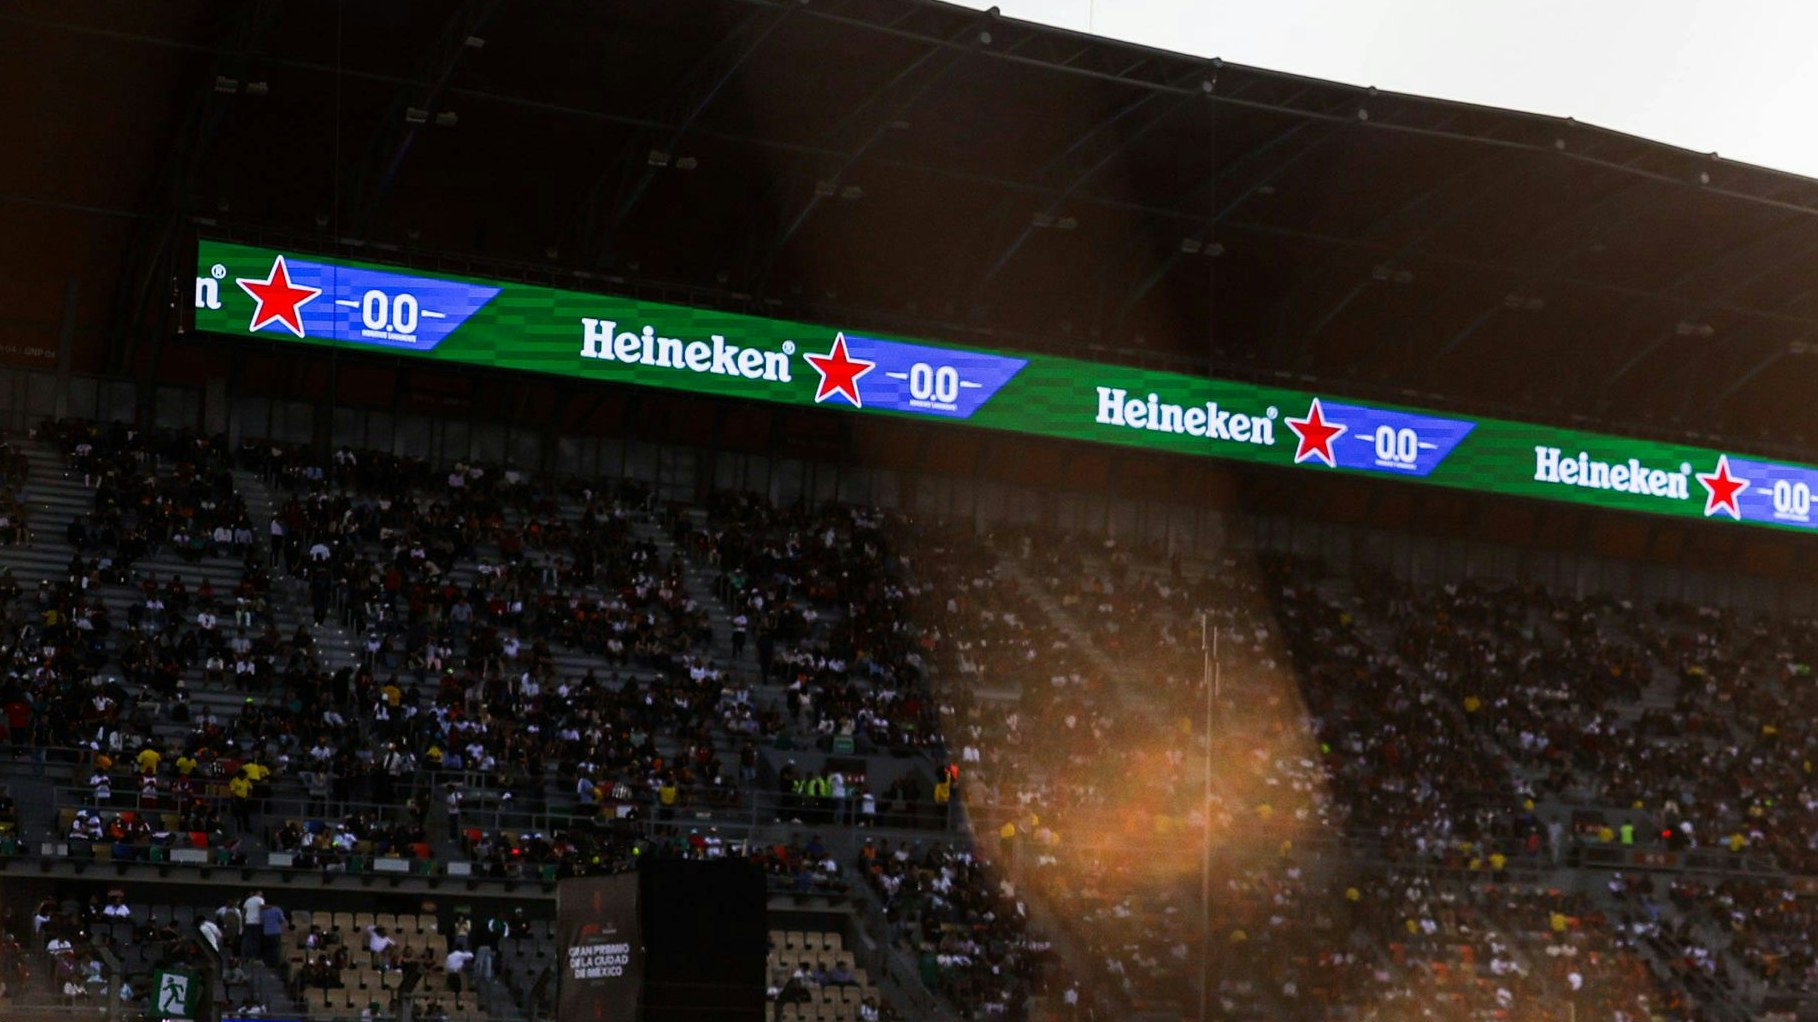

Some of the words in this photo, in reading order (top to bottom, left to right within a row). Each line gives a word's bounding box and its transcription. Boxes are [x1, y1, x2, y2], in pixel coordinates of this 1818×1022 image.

[580, 317, 792, 382] Heineken
[1096, 387, 1275, 445] Heineken
[1534, 446, 1689, 500] Heineken
